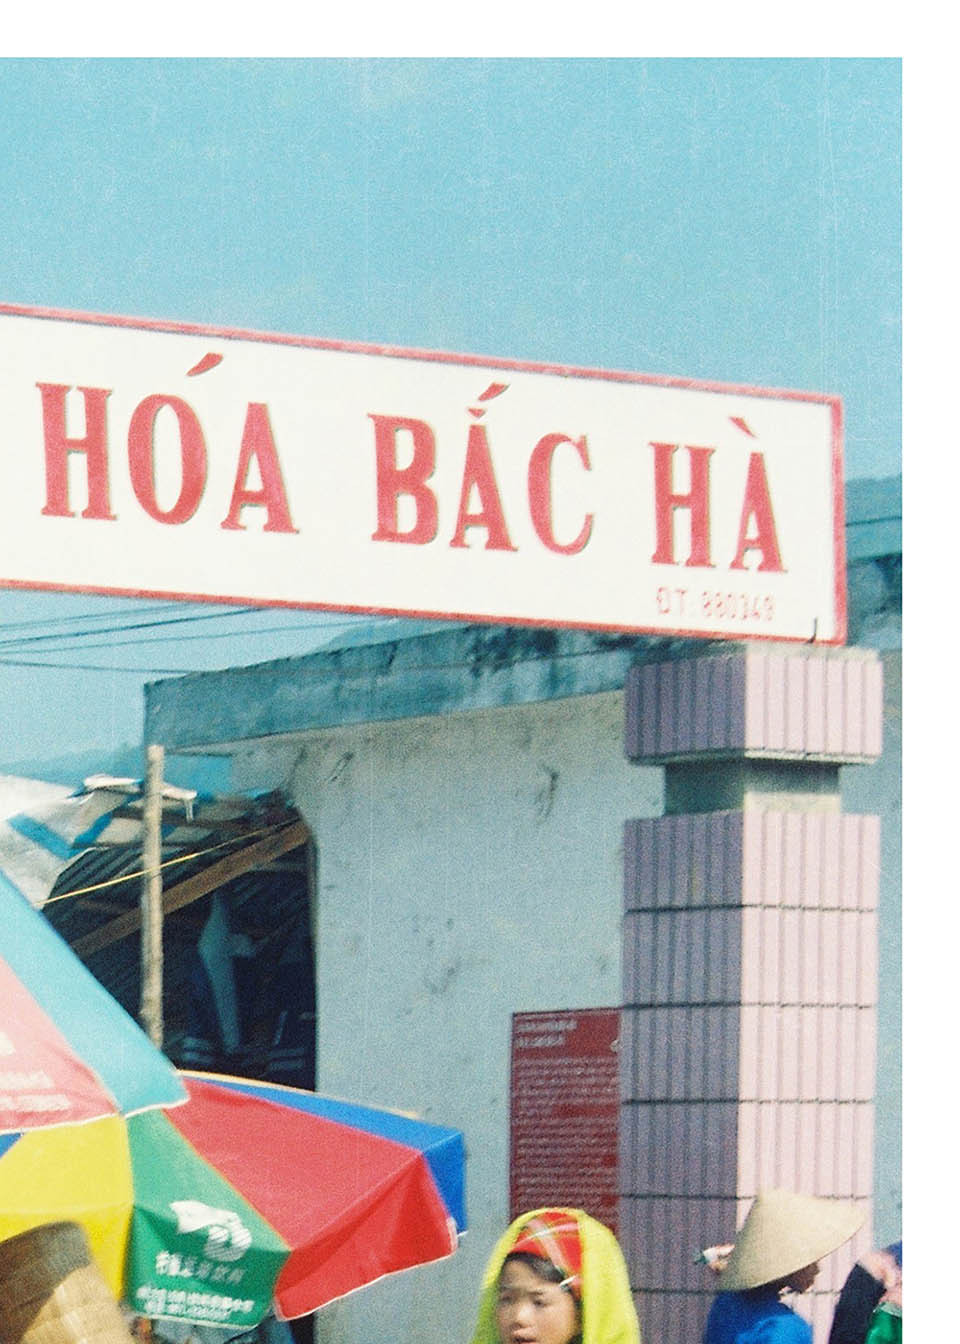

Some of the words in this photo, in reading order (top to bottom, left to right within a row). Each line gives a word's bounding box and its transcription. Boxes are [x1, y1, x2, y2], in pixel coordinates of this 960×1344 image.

[35, 352, 300, 536] HÓA
[367, 382, 595, 556] BẮC
[649, 416, 788, 574] HÀ
